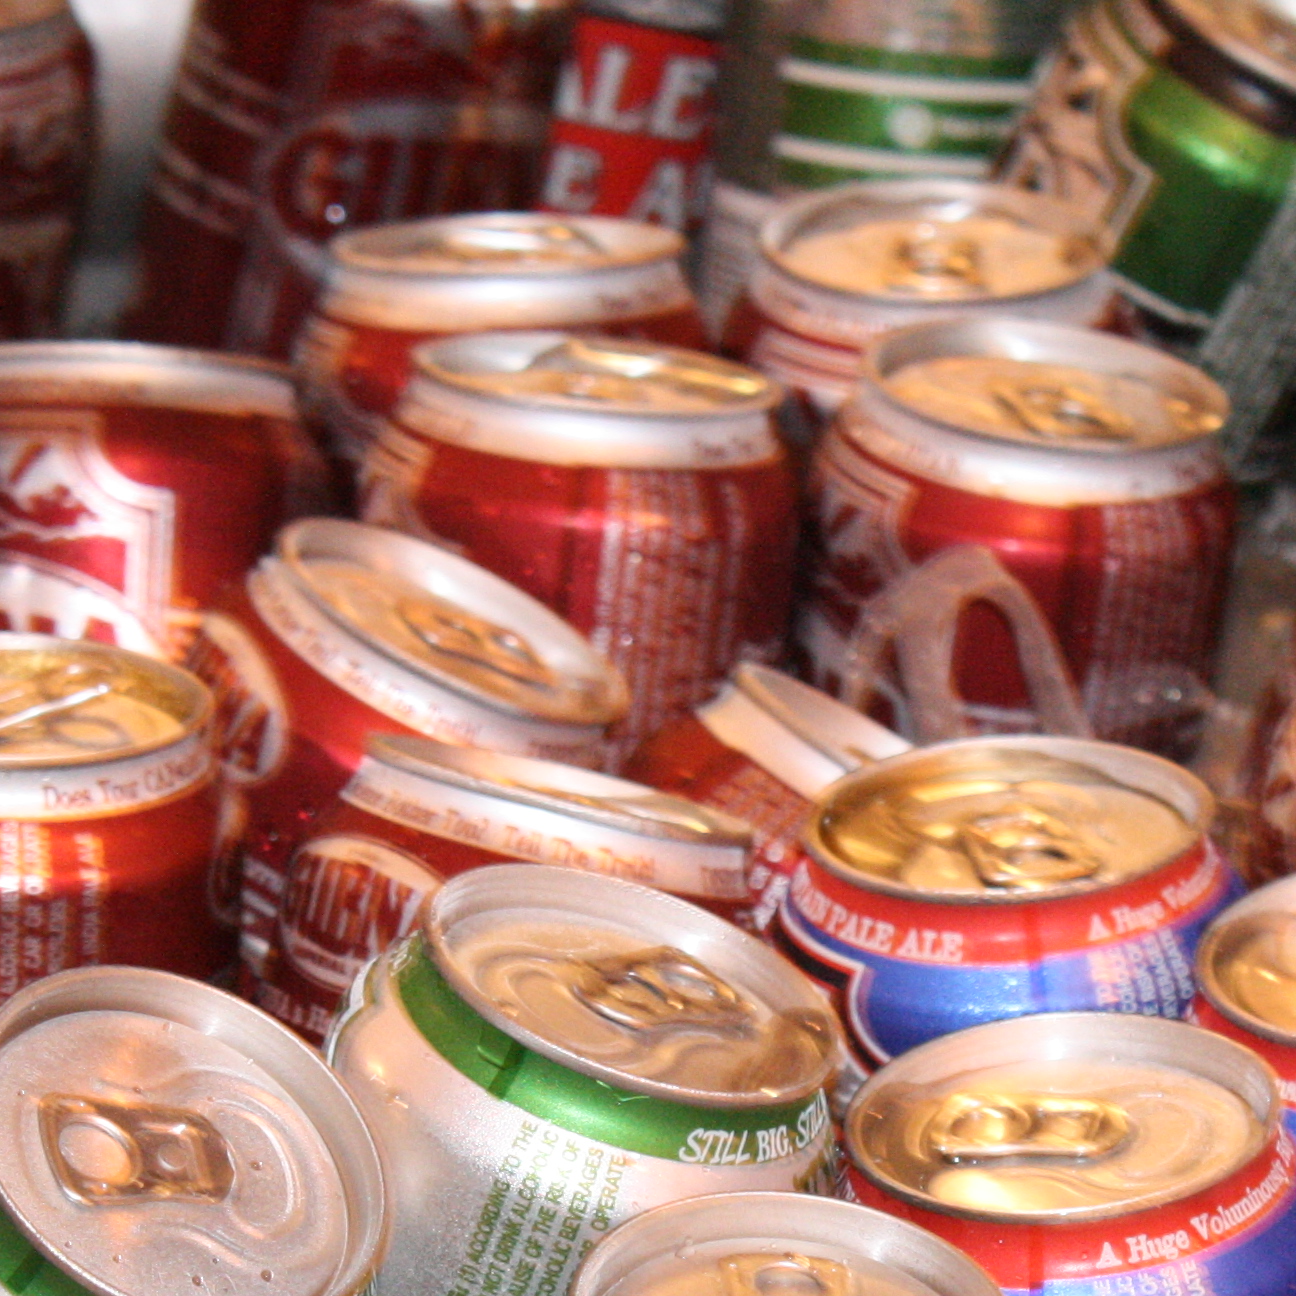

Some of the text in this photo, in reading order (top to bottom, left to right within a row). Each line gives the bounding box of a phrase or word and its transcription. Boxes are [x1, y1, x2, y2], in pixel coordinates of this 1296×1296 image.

[826, 908, 963, 963] PALE ALE
[1088, 914, 1112, 941] A
[678, 1127, 751, 1165] STILL
[1096, 1158, 1291, 1268] A Huge Voluminously
[1137, 1270, 1159, 1295] OF
